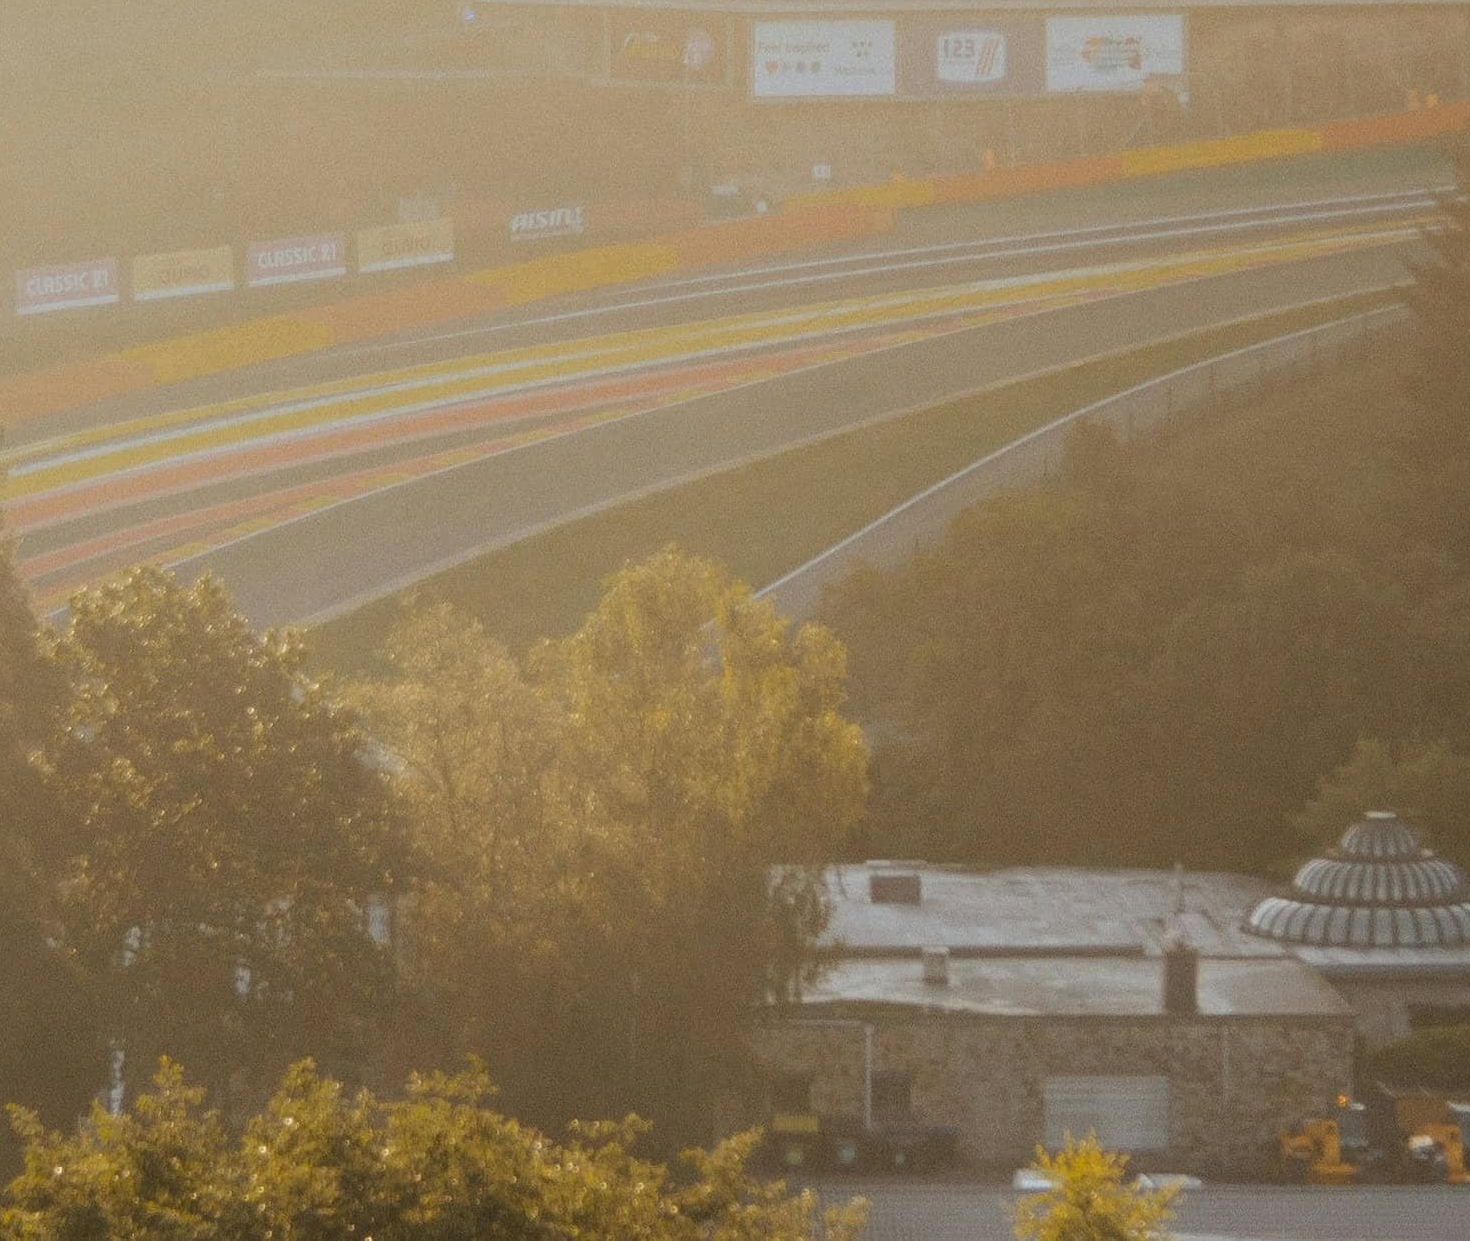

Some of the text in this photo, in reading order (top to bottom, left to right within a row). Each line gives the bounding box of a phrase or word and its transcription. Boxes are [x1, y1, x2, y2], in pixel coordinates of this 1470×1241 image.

[944, 38, 975, 58] 123
[257, 243, 337, 269] CLASSIC 21
[25, 270, 89, 296] CLASSIC
